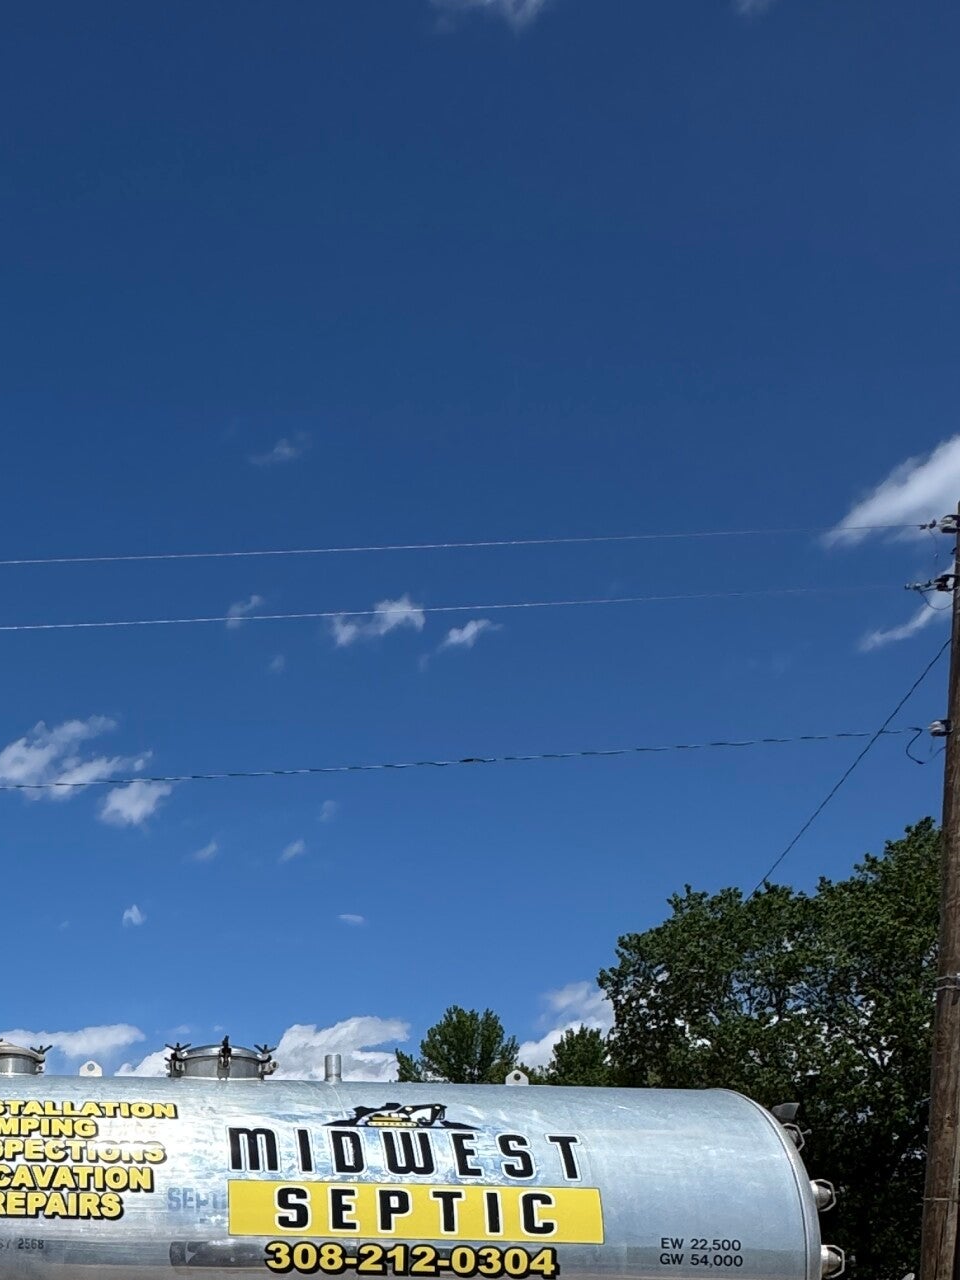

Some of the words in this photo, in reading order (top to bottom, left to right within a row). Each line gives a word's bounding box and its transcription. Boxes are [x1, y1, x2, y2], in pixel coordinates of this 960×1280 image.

[228, 1126, 582, 1182] MIDWEST
[275, 1186, 558, 1237] SEPTIC
[264, 1240, 560, 1280] 308-212-0304
[659, 1252, 684, 1265] GW
[689, 1253, 744, 1268] 54,000
[661, 1237, 684, 1249] EW
[690, 1238, 742, 1252] 22,500
